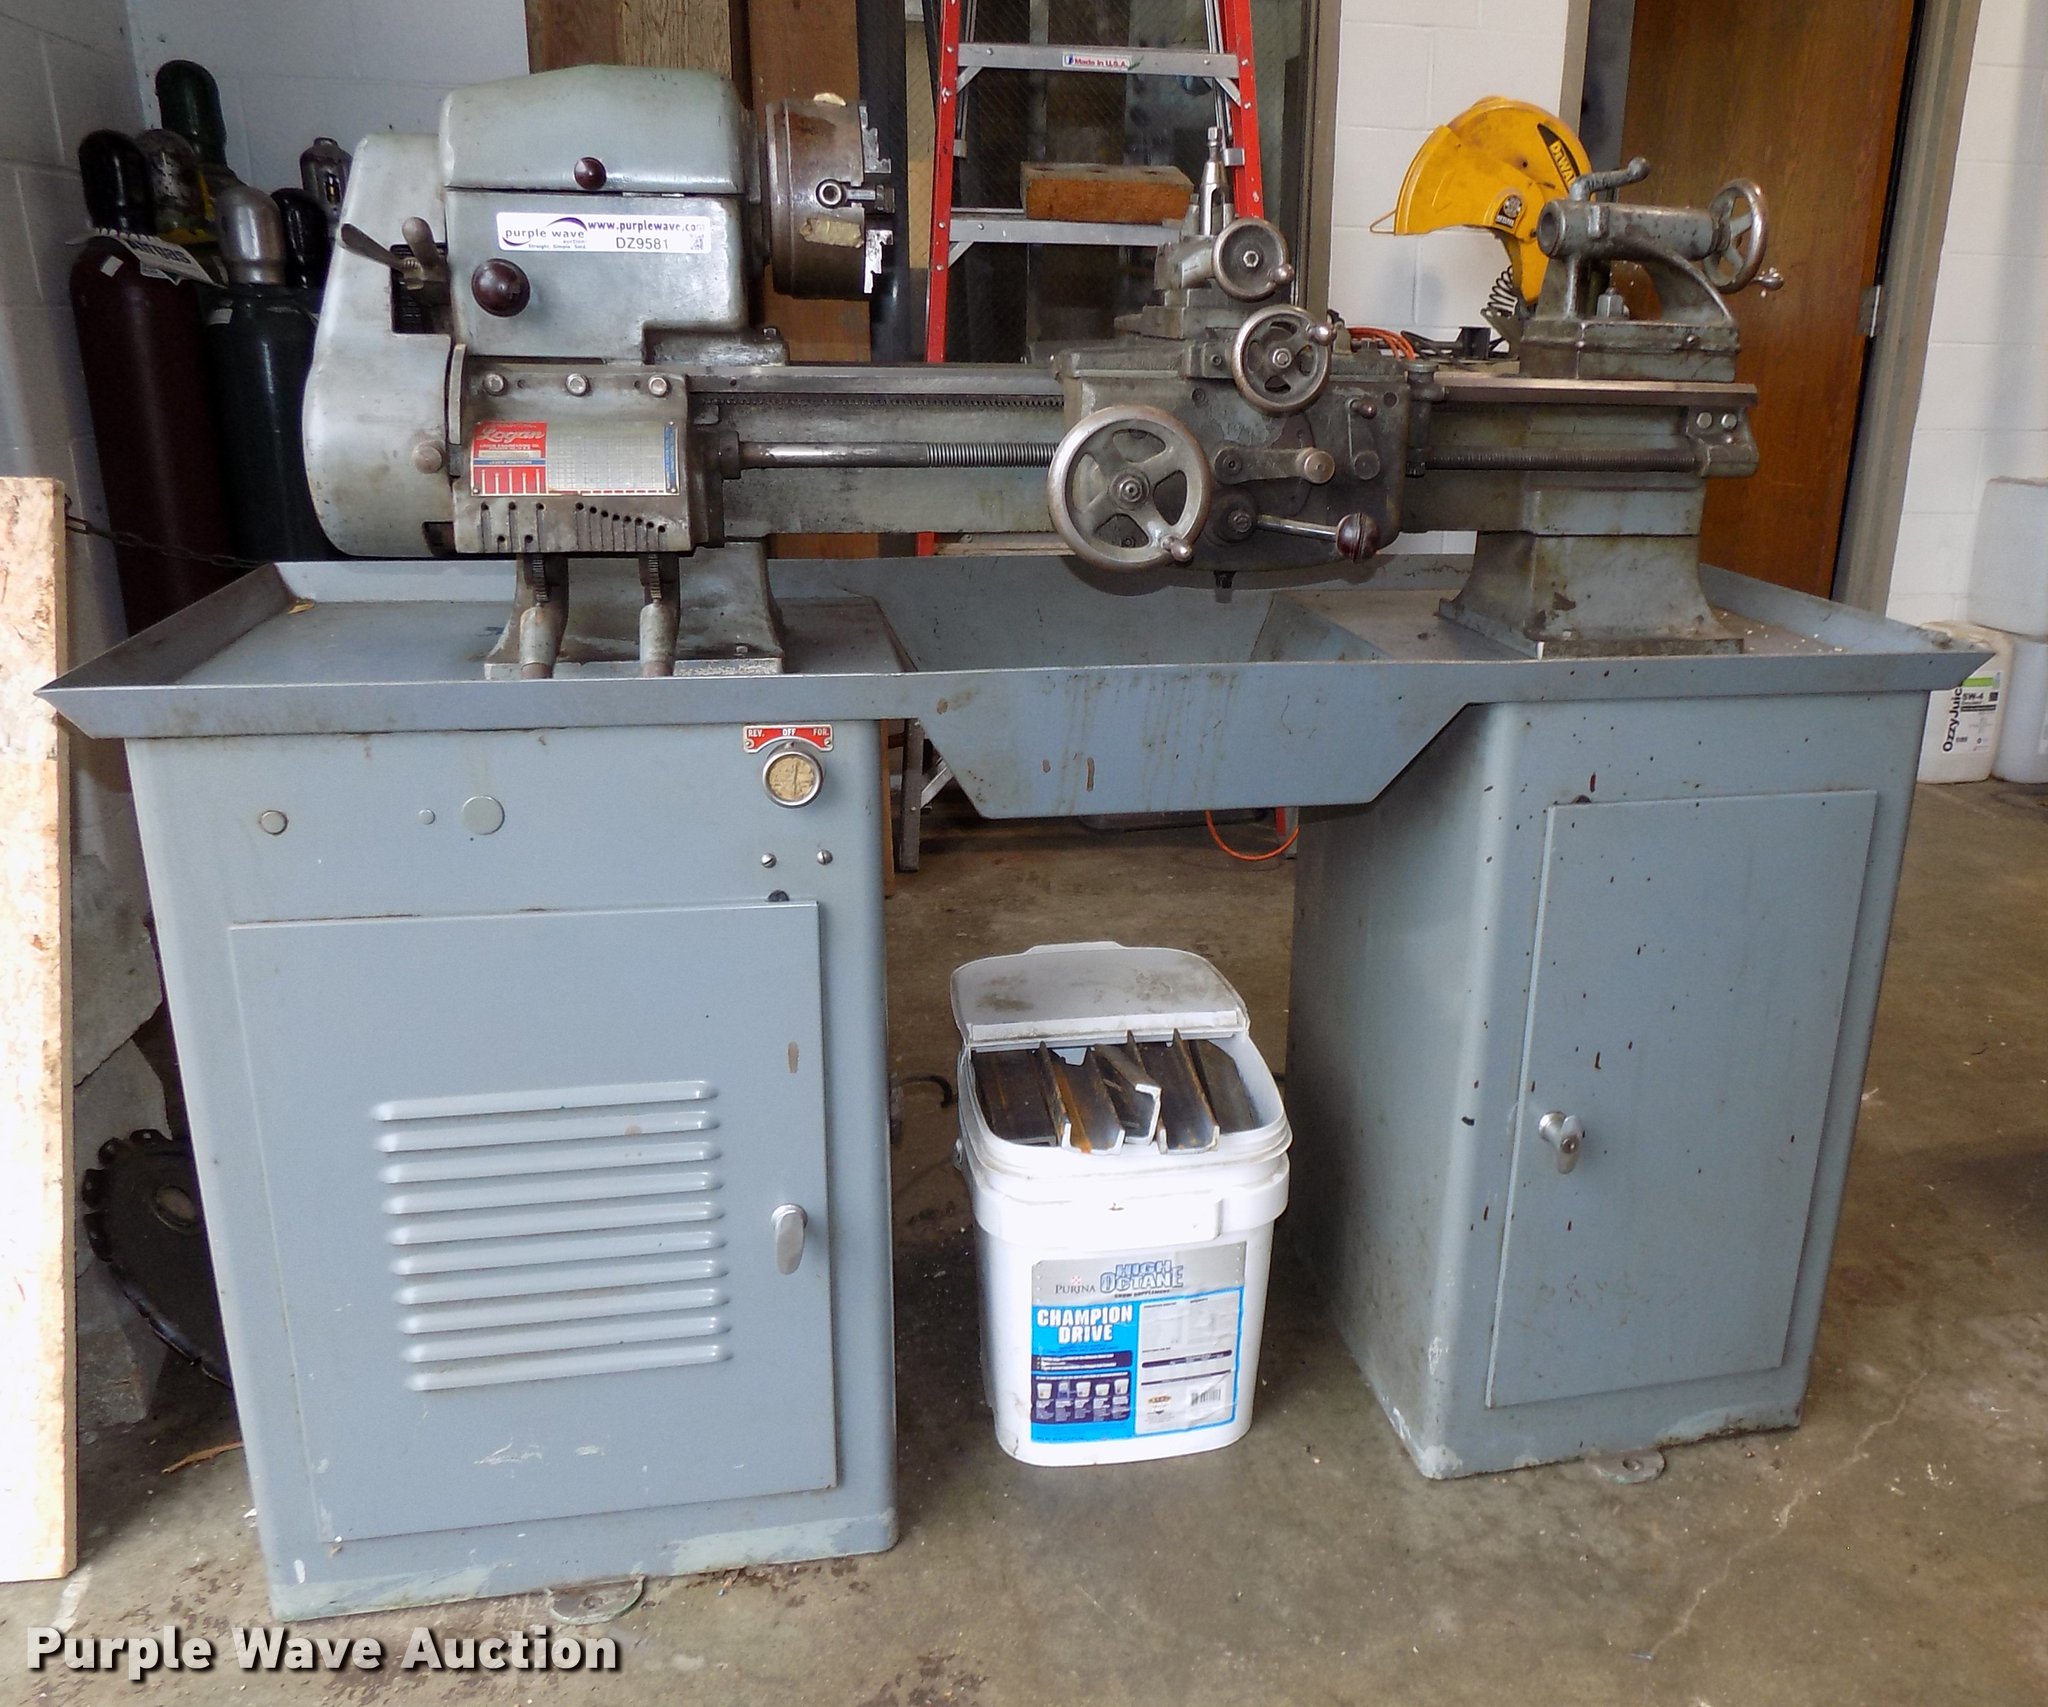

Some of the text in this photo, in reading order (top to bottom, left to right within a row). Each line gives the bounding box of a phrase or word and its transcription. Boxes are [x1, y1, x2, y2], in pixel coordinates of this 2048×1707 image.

[1074, 57, 1095, 65] Made
[1549, 140, 1577, 187] DEWA
[505, 228, 547, 238] purple
[616, 237, 669, 249] DZ9581
[476, 426, 545, 443] Logan
[1942, 688, 1962, 752] OzzyJuic
[748, 728, 830, 738] REV. OFF FOR.
[1115, 1260, 1172, 1279] HIGH
[1100, 1265, 1184, 1294] OCTANE
[1055, 1284, 1096, 1295] PURINA
[1037, 1304, 1133, 1328] CHAMPION
[1058, 1324, 1114, 1345] DRIVE
